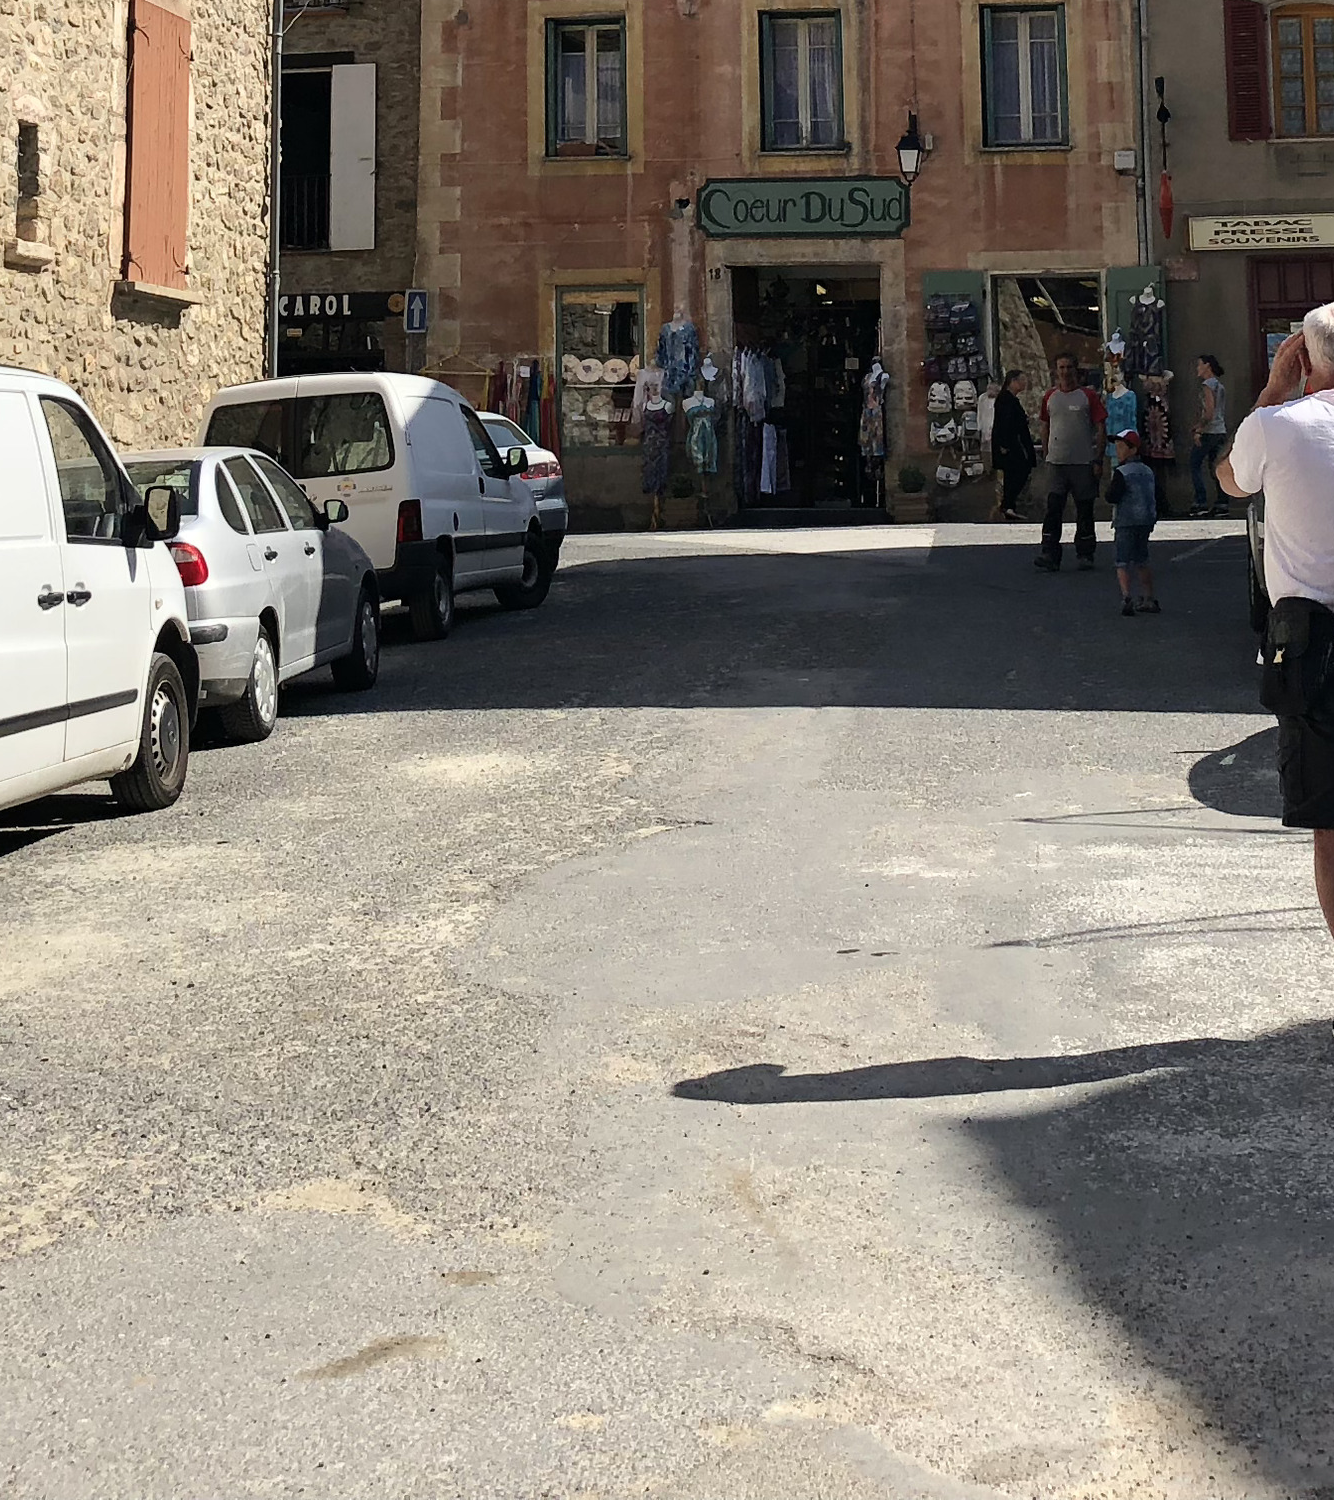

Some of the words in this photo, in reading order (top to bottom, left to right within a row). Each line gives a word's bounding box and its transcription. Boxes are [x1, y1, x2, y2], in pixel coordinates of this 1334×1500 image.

[701, 188, 797, 229] Coeur
[800, 191, 845, 224] Du
[840, 187, 903, 228] Sud
[1214, 218, 1312, 228] TABAC
[1213, 227, 1314, 236] PRESSE
[1208, 235, 1320, 245] SOUVENIRS
[709, 267, 721, 280] 18
[278, 294, 352, 317] CAROL
